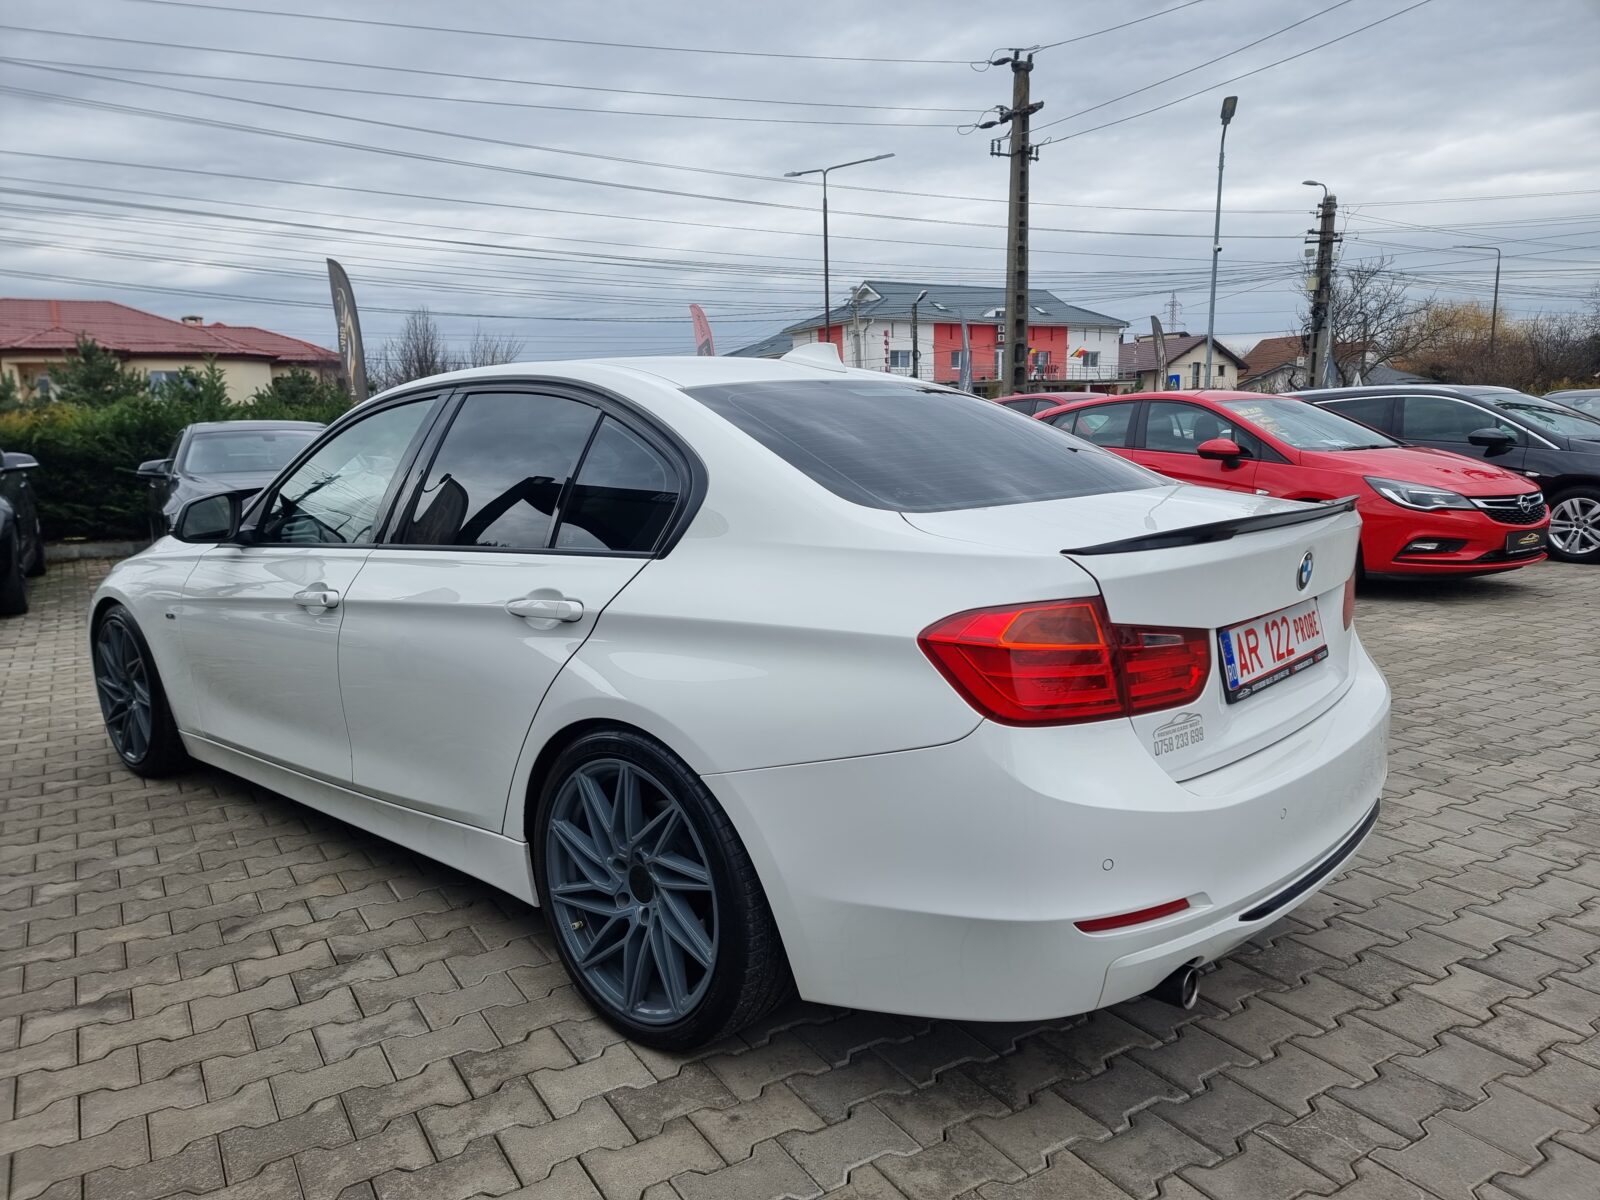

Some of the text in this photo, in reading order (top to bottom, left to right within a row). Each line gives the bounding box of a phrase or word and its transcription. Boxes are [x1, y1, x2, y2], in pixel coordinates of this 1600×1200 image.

[1237, 610, 1319, 678] AR 122 PROBE
[1227, 663, 1238, 681] RO
[1175, 731, 1190, 749] 233
